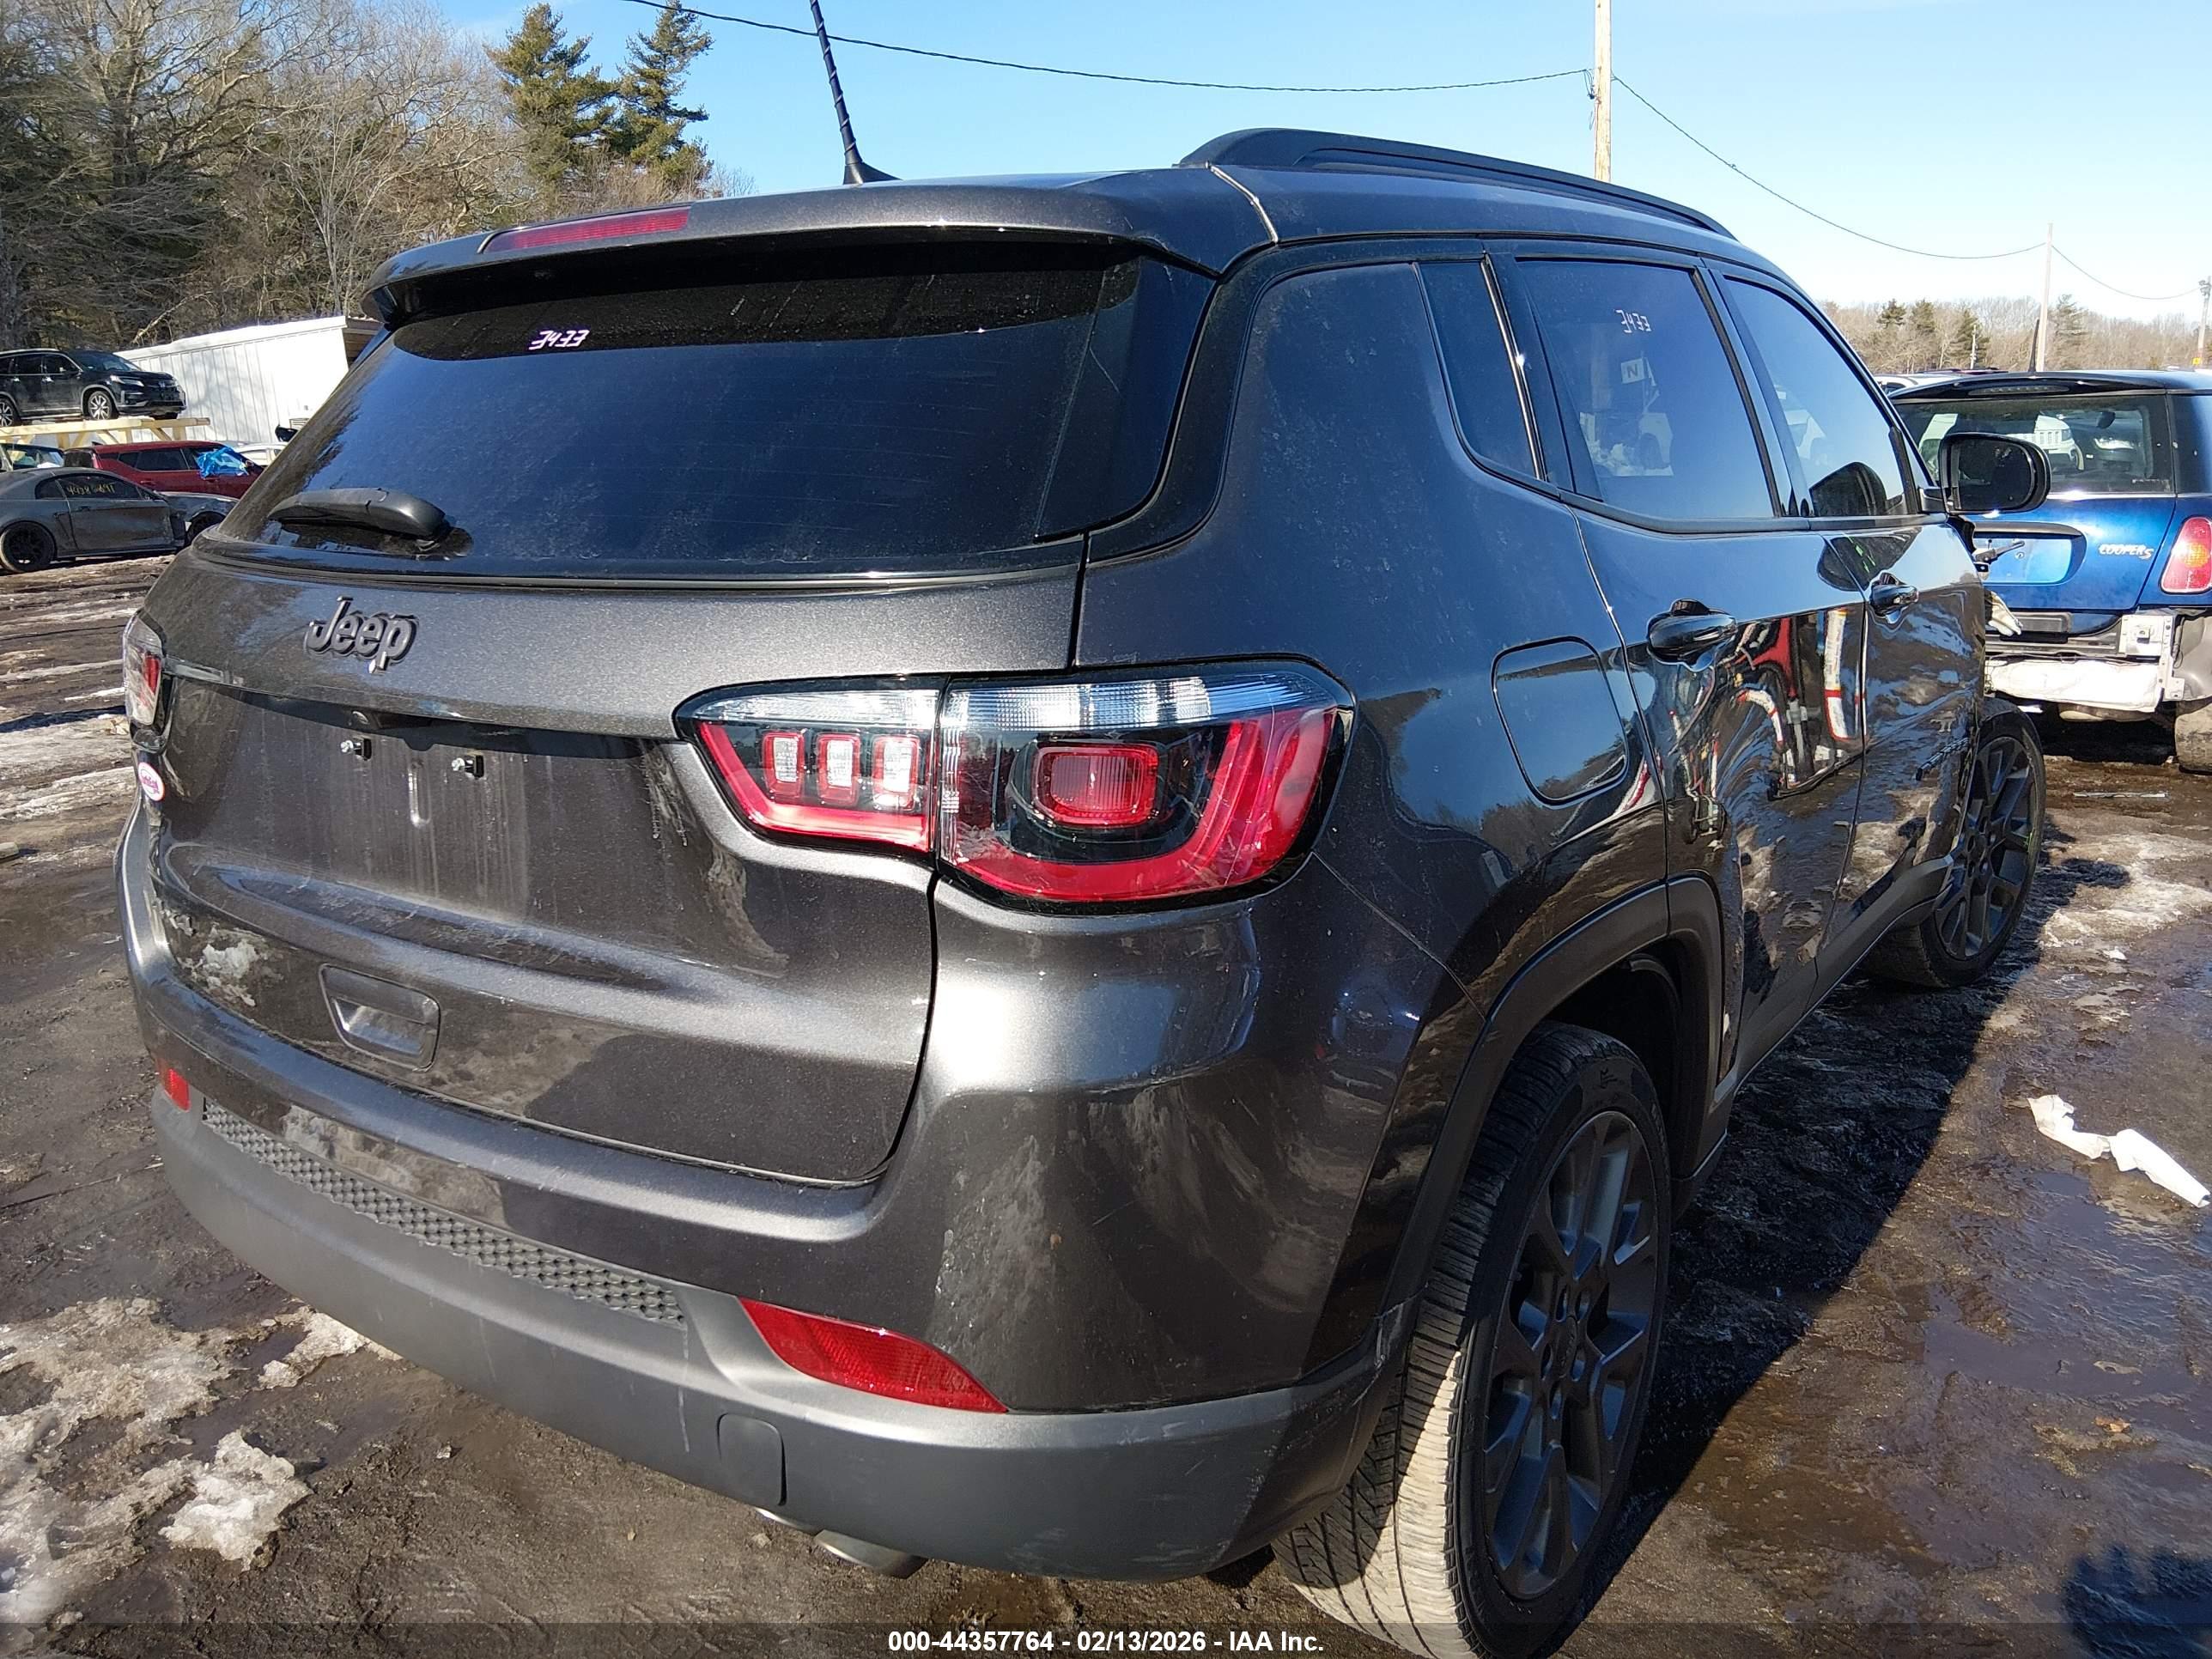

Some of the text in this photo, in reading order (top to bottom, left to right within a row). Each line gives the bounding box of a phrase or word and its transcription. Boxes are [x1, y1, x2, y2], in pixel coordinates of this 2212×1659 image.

[1615, 309, 1652, 333] 3433
[528, 329, 590, 350] 3433
[2098, 544, 2154, 560] COOPER S
[305, 595, 419, 674] Jeep
